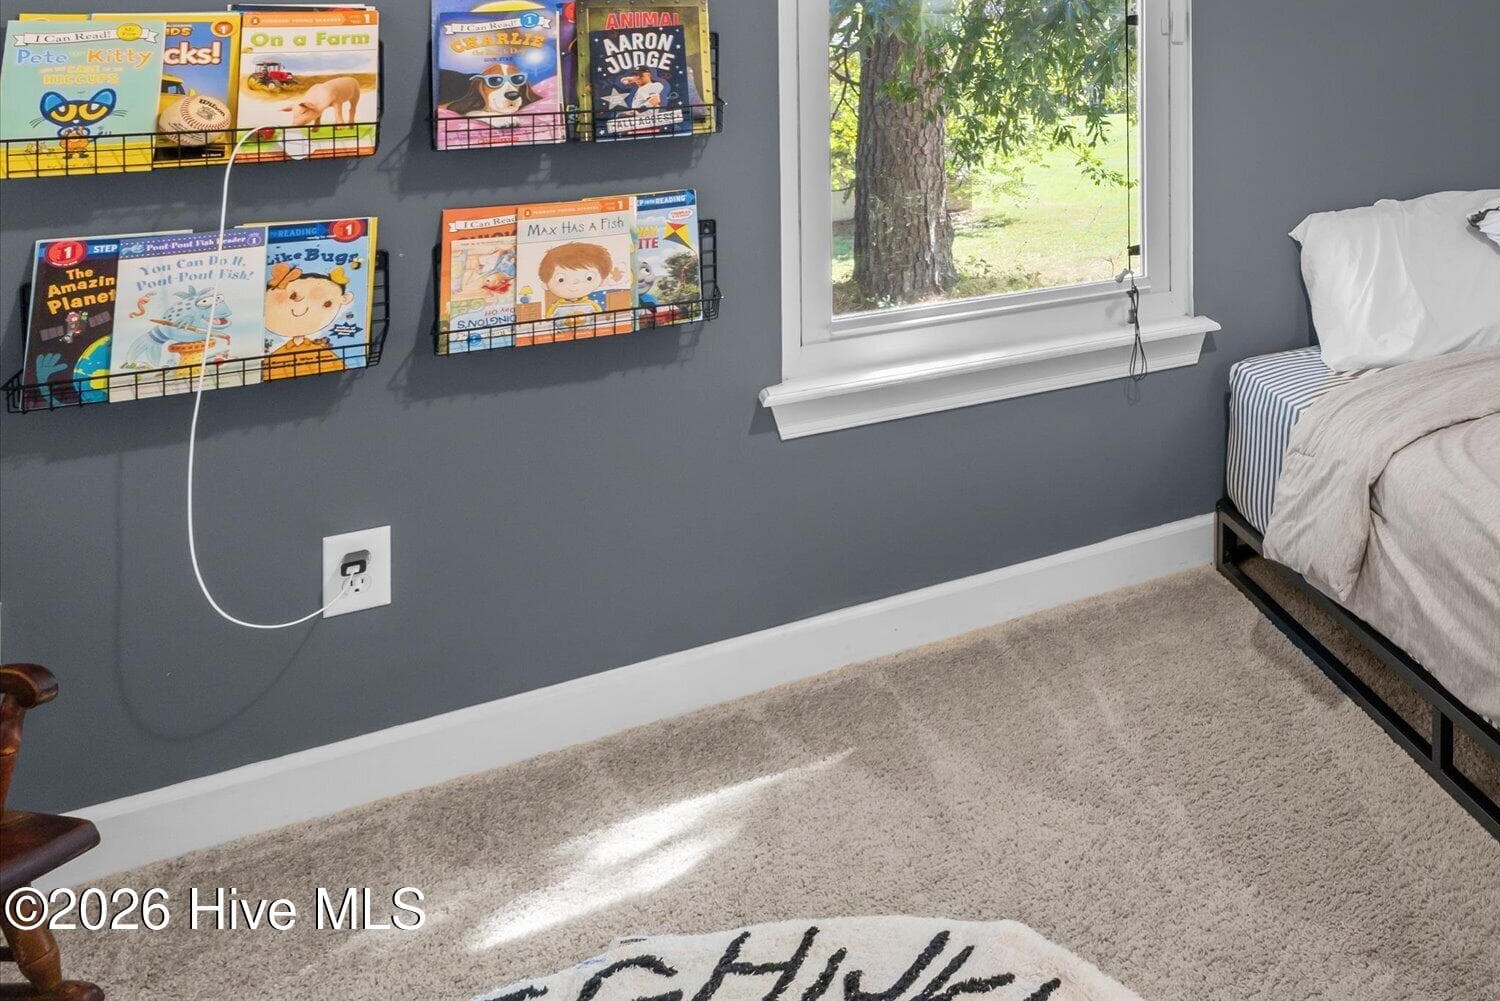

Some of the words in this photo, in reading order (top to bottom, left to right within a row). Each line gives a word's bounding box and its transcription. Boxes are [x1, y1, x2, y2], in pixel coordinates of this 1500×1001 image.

[44, 32, 71, 43] Can
[74, 30, 112, 41] Read!
[250, 32, 284, 47] On
[292, 34, 307, 46] a
[315, 31, 370, 46] Farm
[449, 30, 545, 54] CHARLIE
[603, 32, 674, 56] AARON
[17, 48, 69, 64] Pete
[86, 47, 154, 68] Kitty
[604, 50, 676, 74] JUDGE
[199, 98, 226, 117] Wilson
[655, 194, 687, 205] READING
[277, 227, 318, 238] READING
[345, 224, 353, 236] 1
[93, 244, 118, 254] STEP
[195, 239, 214, 248] Fish
[64, 246, 73, 259] 1
[65, 267, 94, 281] The
[139, 263, 171, 276] You
[176, 258, 203, 268] Can
[48, 276, 115, 299] Amazin
